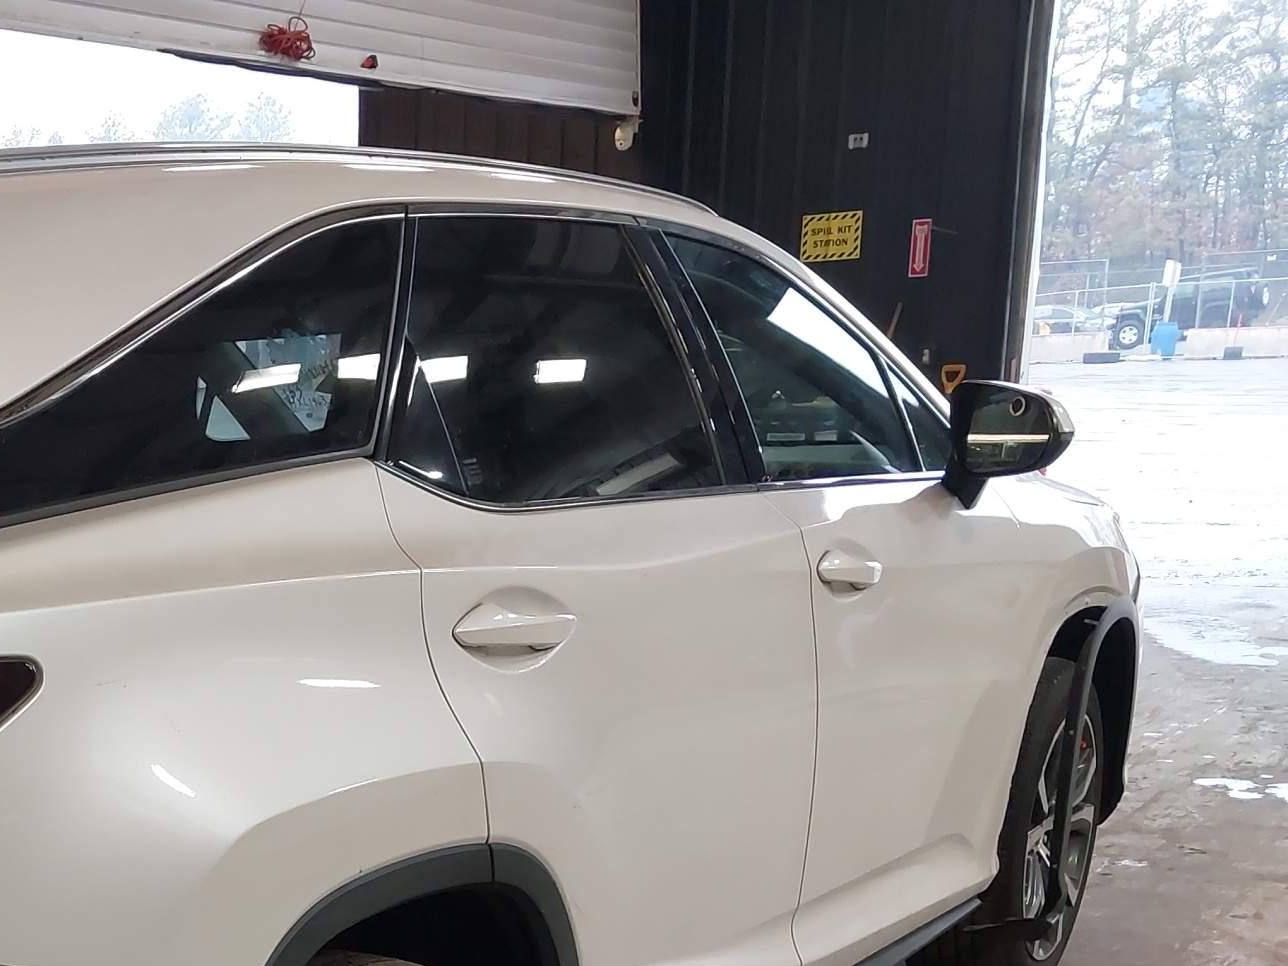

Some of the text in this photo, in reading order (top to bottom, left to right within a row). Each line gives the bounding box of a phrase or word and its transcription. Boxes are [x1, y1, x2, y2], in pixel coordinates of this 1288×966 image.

[811, 225, 853, 236] SPILL KIT
[813, 238, 849, 249] STATION
